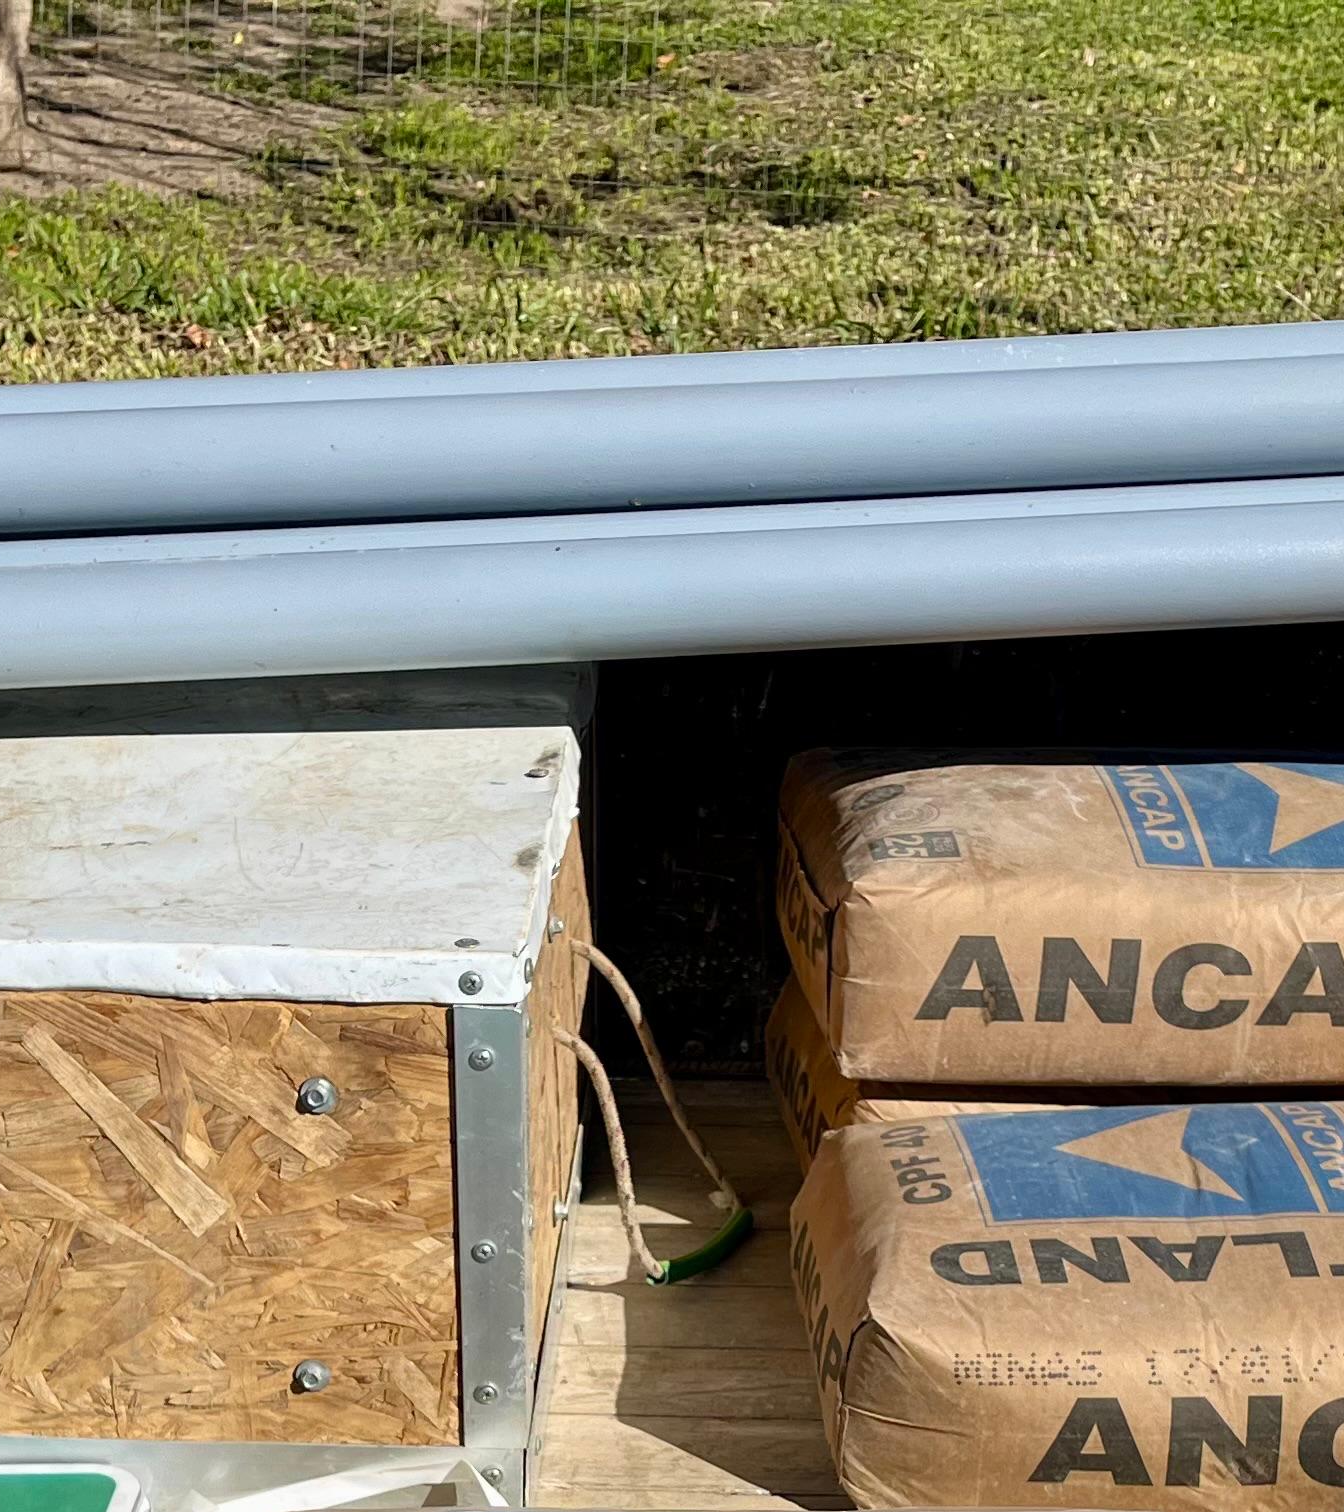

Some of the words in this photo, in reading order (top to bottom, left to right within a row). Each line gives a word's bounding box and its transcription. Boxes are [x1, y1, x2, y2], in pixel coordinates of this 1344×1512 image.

[884, 834, 929, 858] 25
[880, 1125, 930, 1148] 40
[890, 1155, 952, 1205] CPF
[953, 1350, 1103, 1387] MINAS
